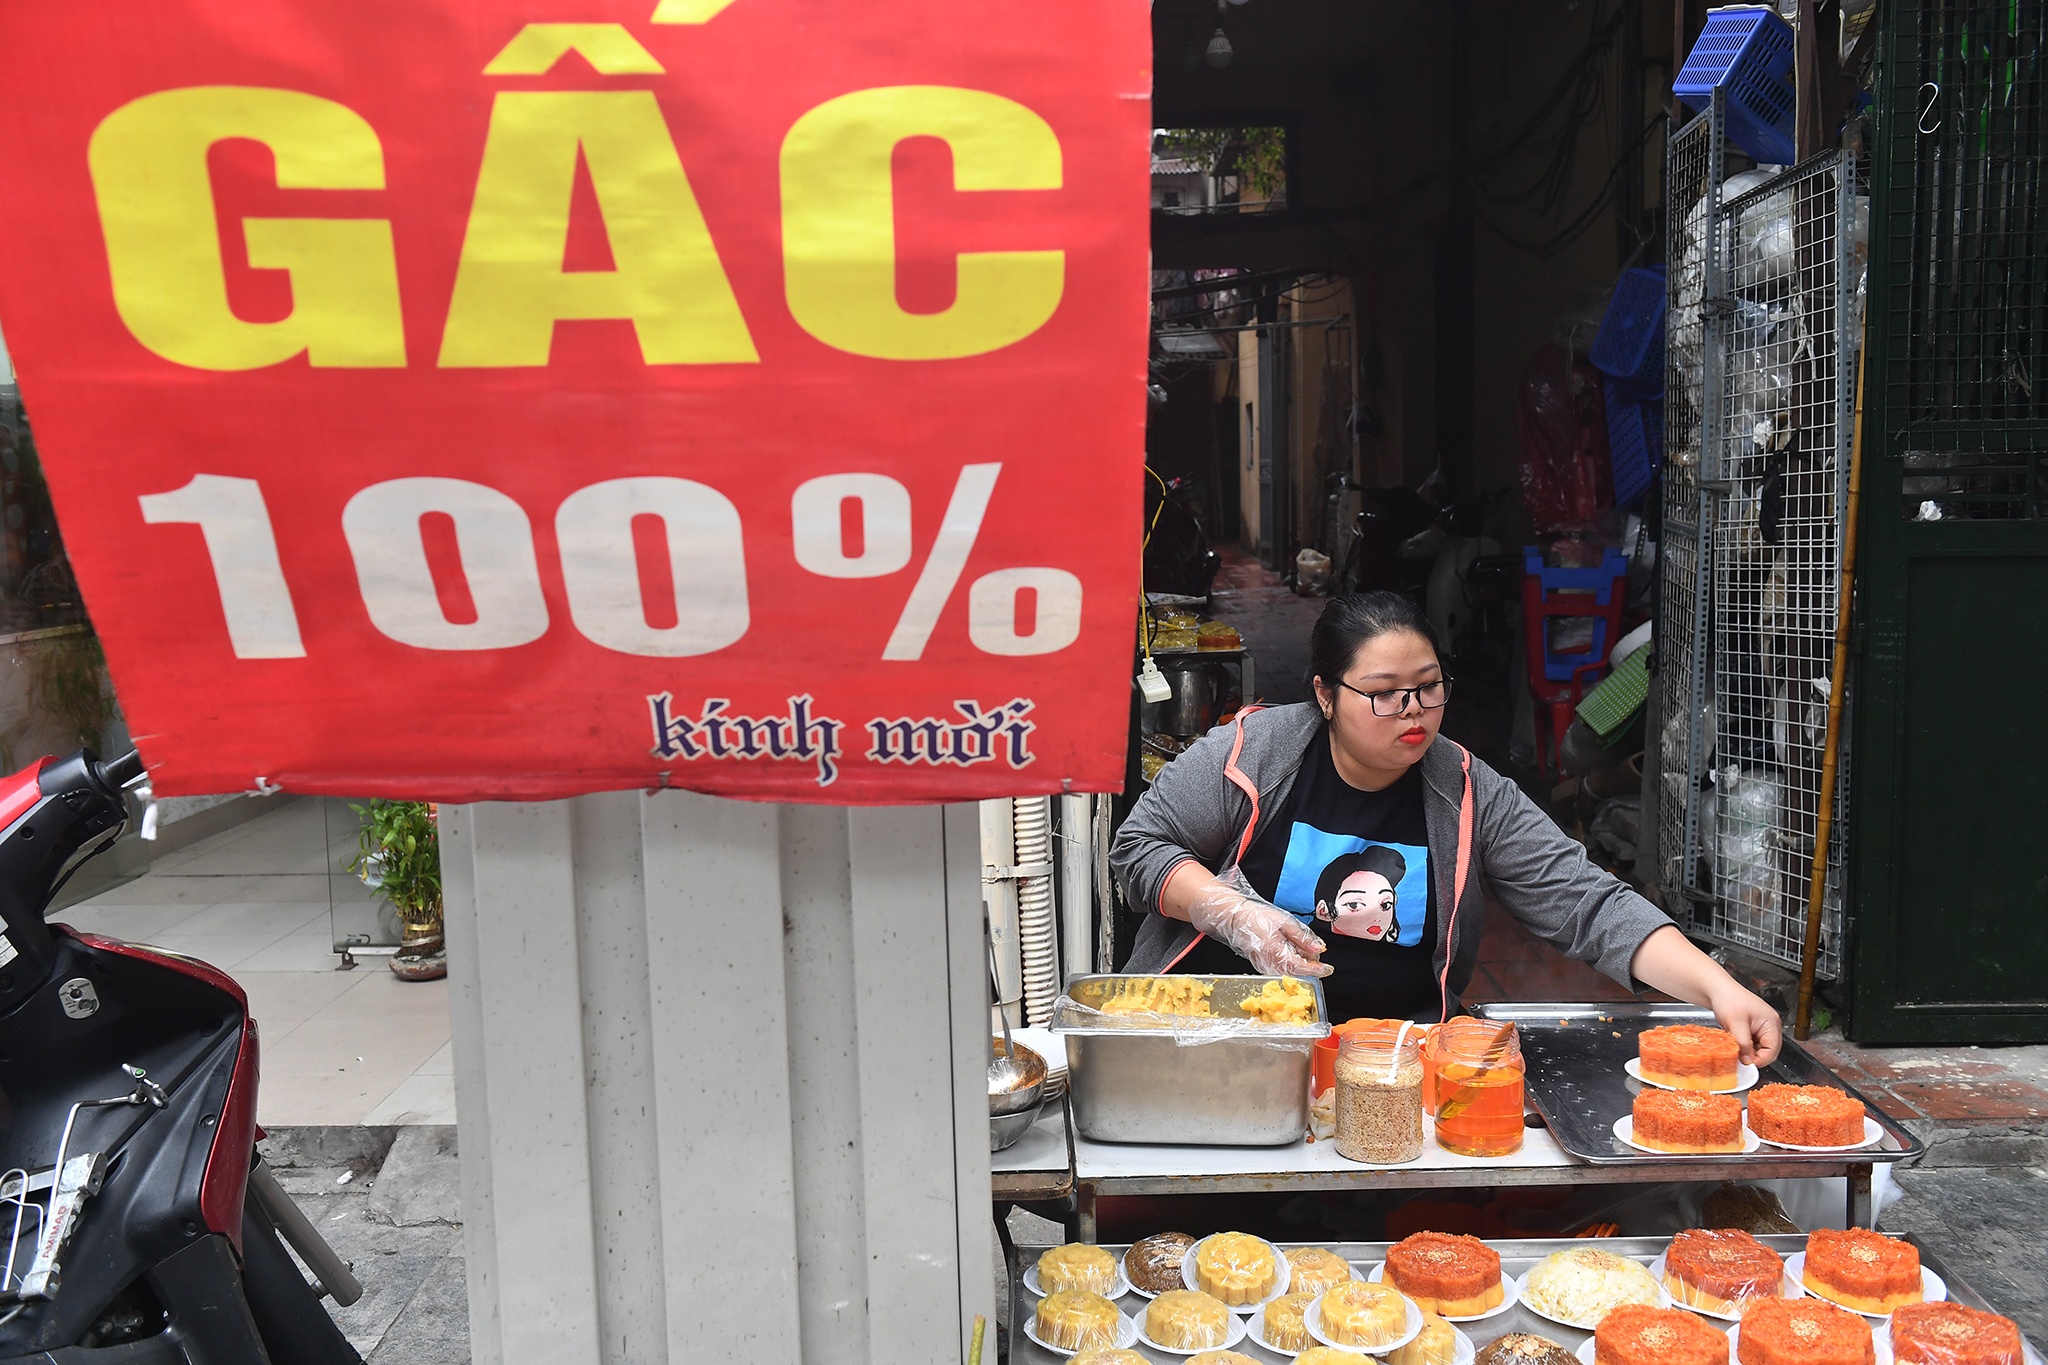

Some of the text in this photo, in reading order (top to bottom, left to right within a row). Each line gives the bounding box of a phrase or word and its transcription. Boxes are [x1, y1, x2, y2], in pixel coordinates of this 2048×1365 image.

[88, 0, 1065, 371] GẤC
[139, 462, 1083, 661] 100%
[646, 690, 1036, 787] kính mời
